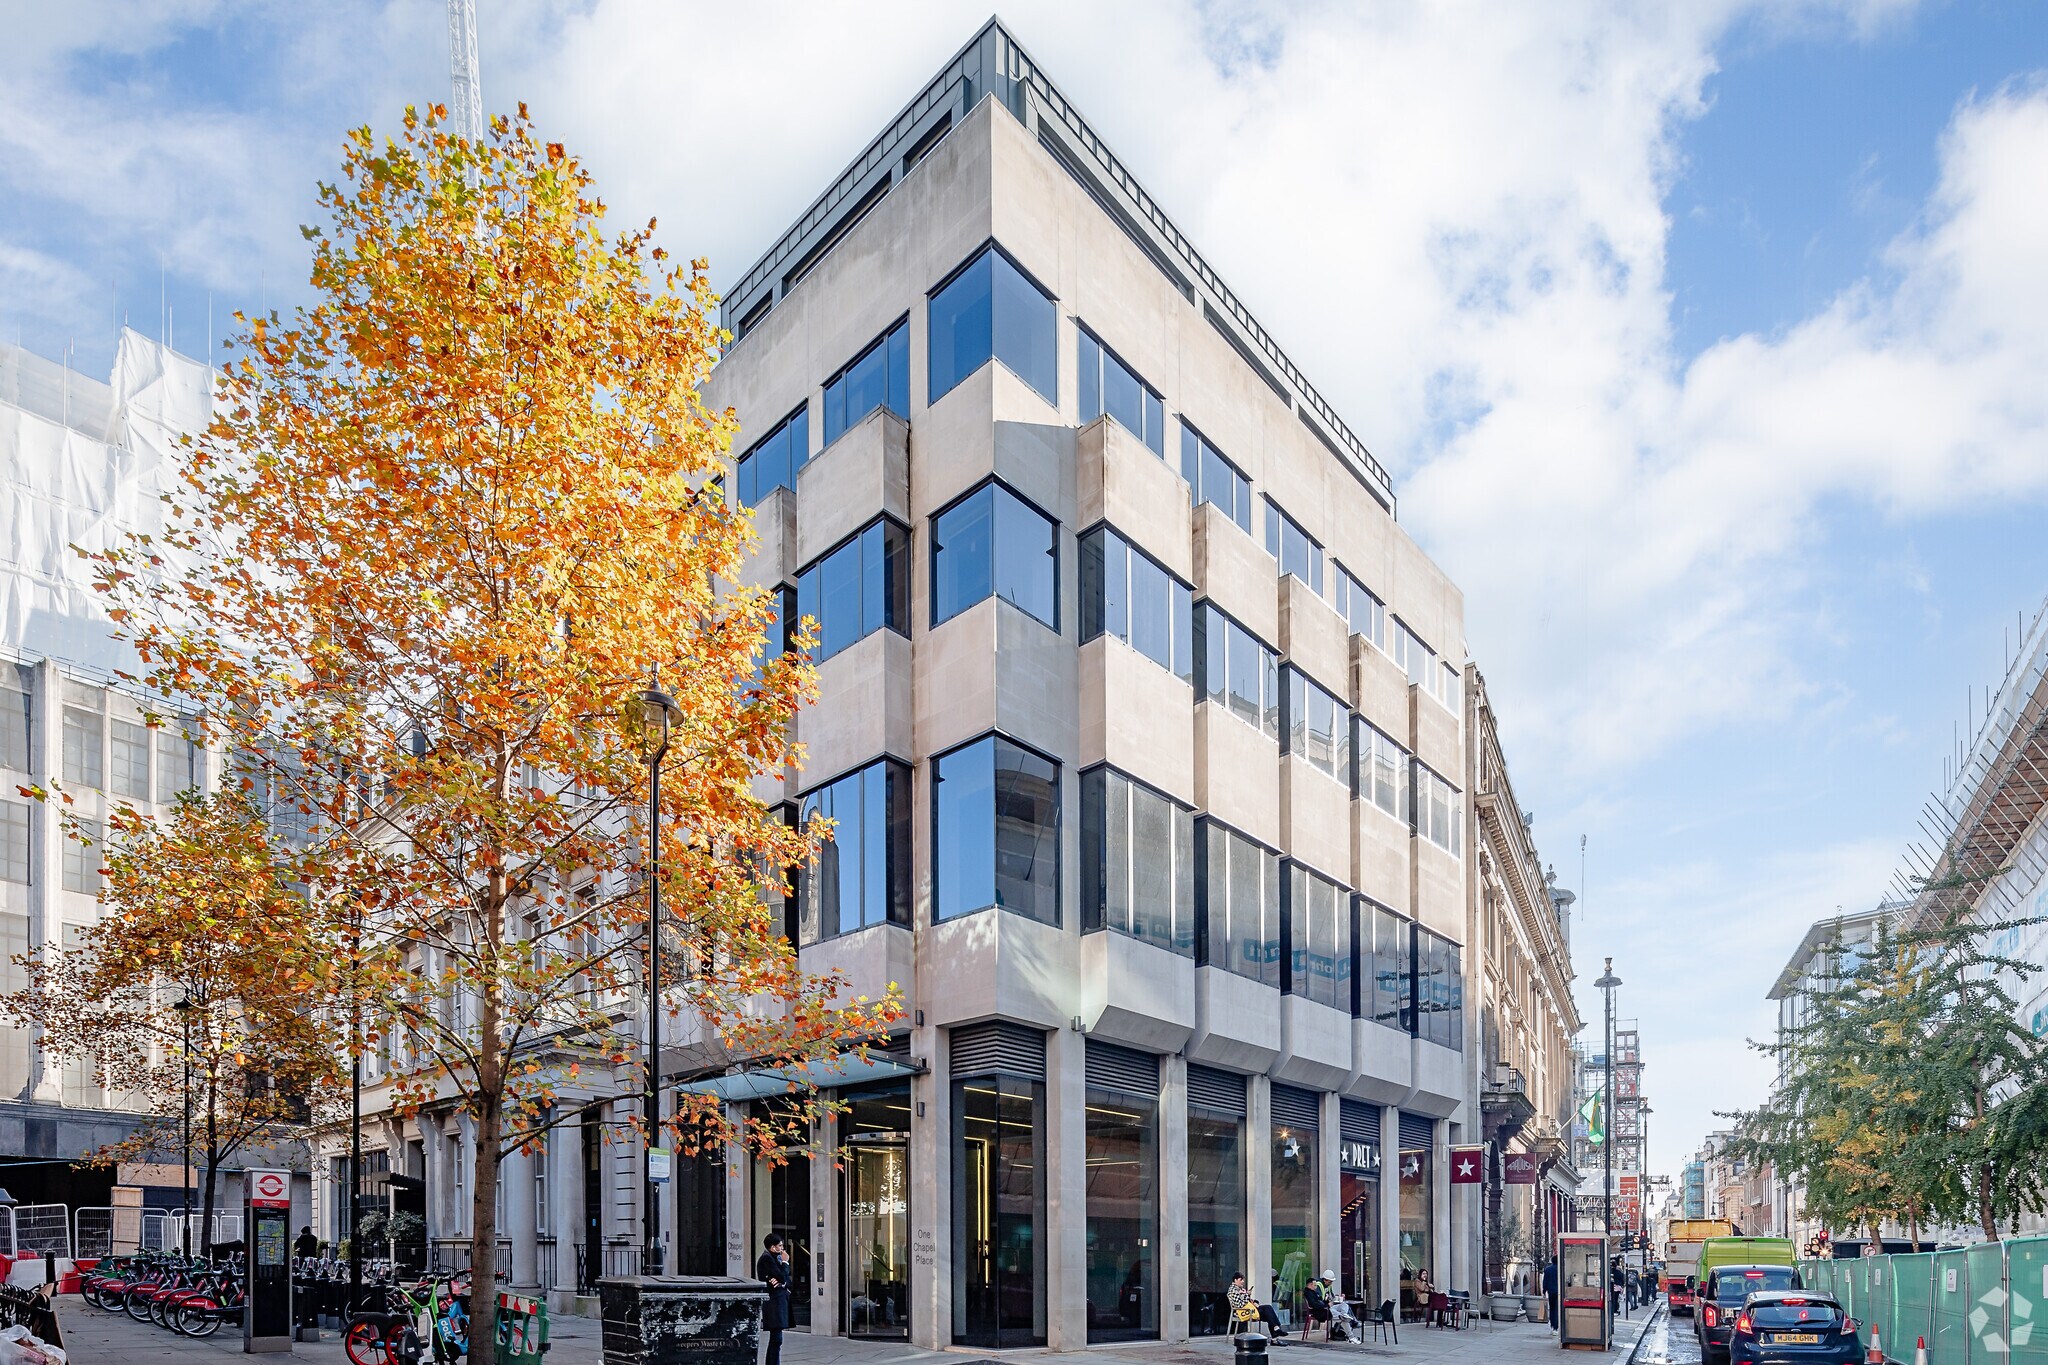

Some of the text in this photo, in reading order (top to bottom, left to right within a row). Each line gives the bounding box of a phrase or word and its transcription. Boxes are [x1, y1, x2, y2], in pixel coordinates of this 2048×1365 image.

[1353, 1143, 1370, 1168] PRET
[917, 1229, 931, 1239] One
[913, 1242, 936, 1254] Chapel
[915, 1255, 934, 1265] Place
[701, 1340, 719, 1348] Waste
